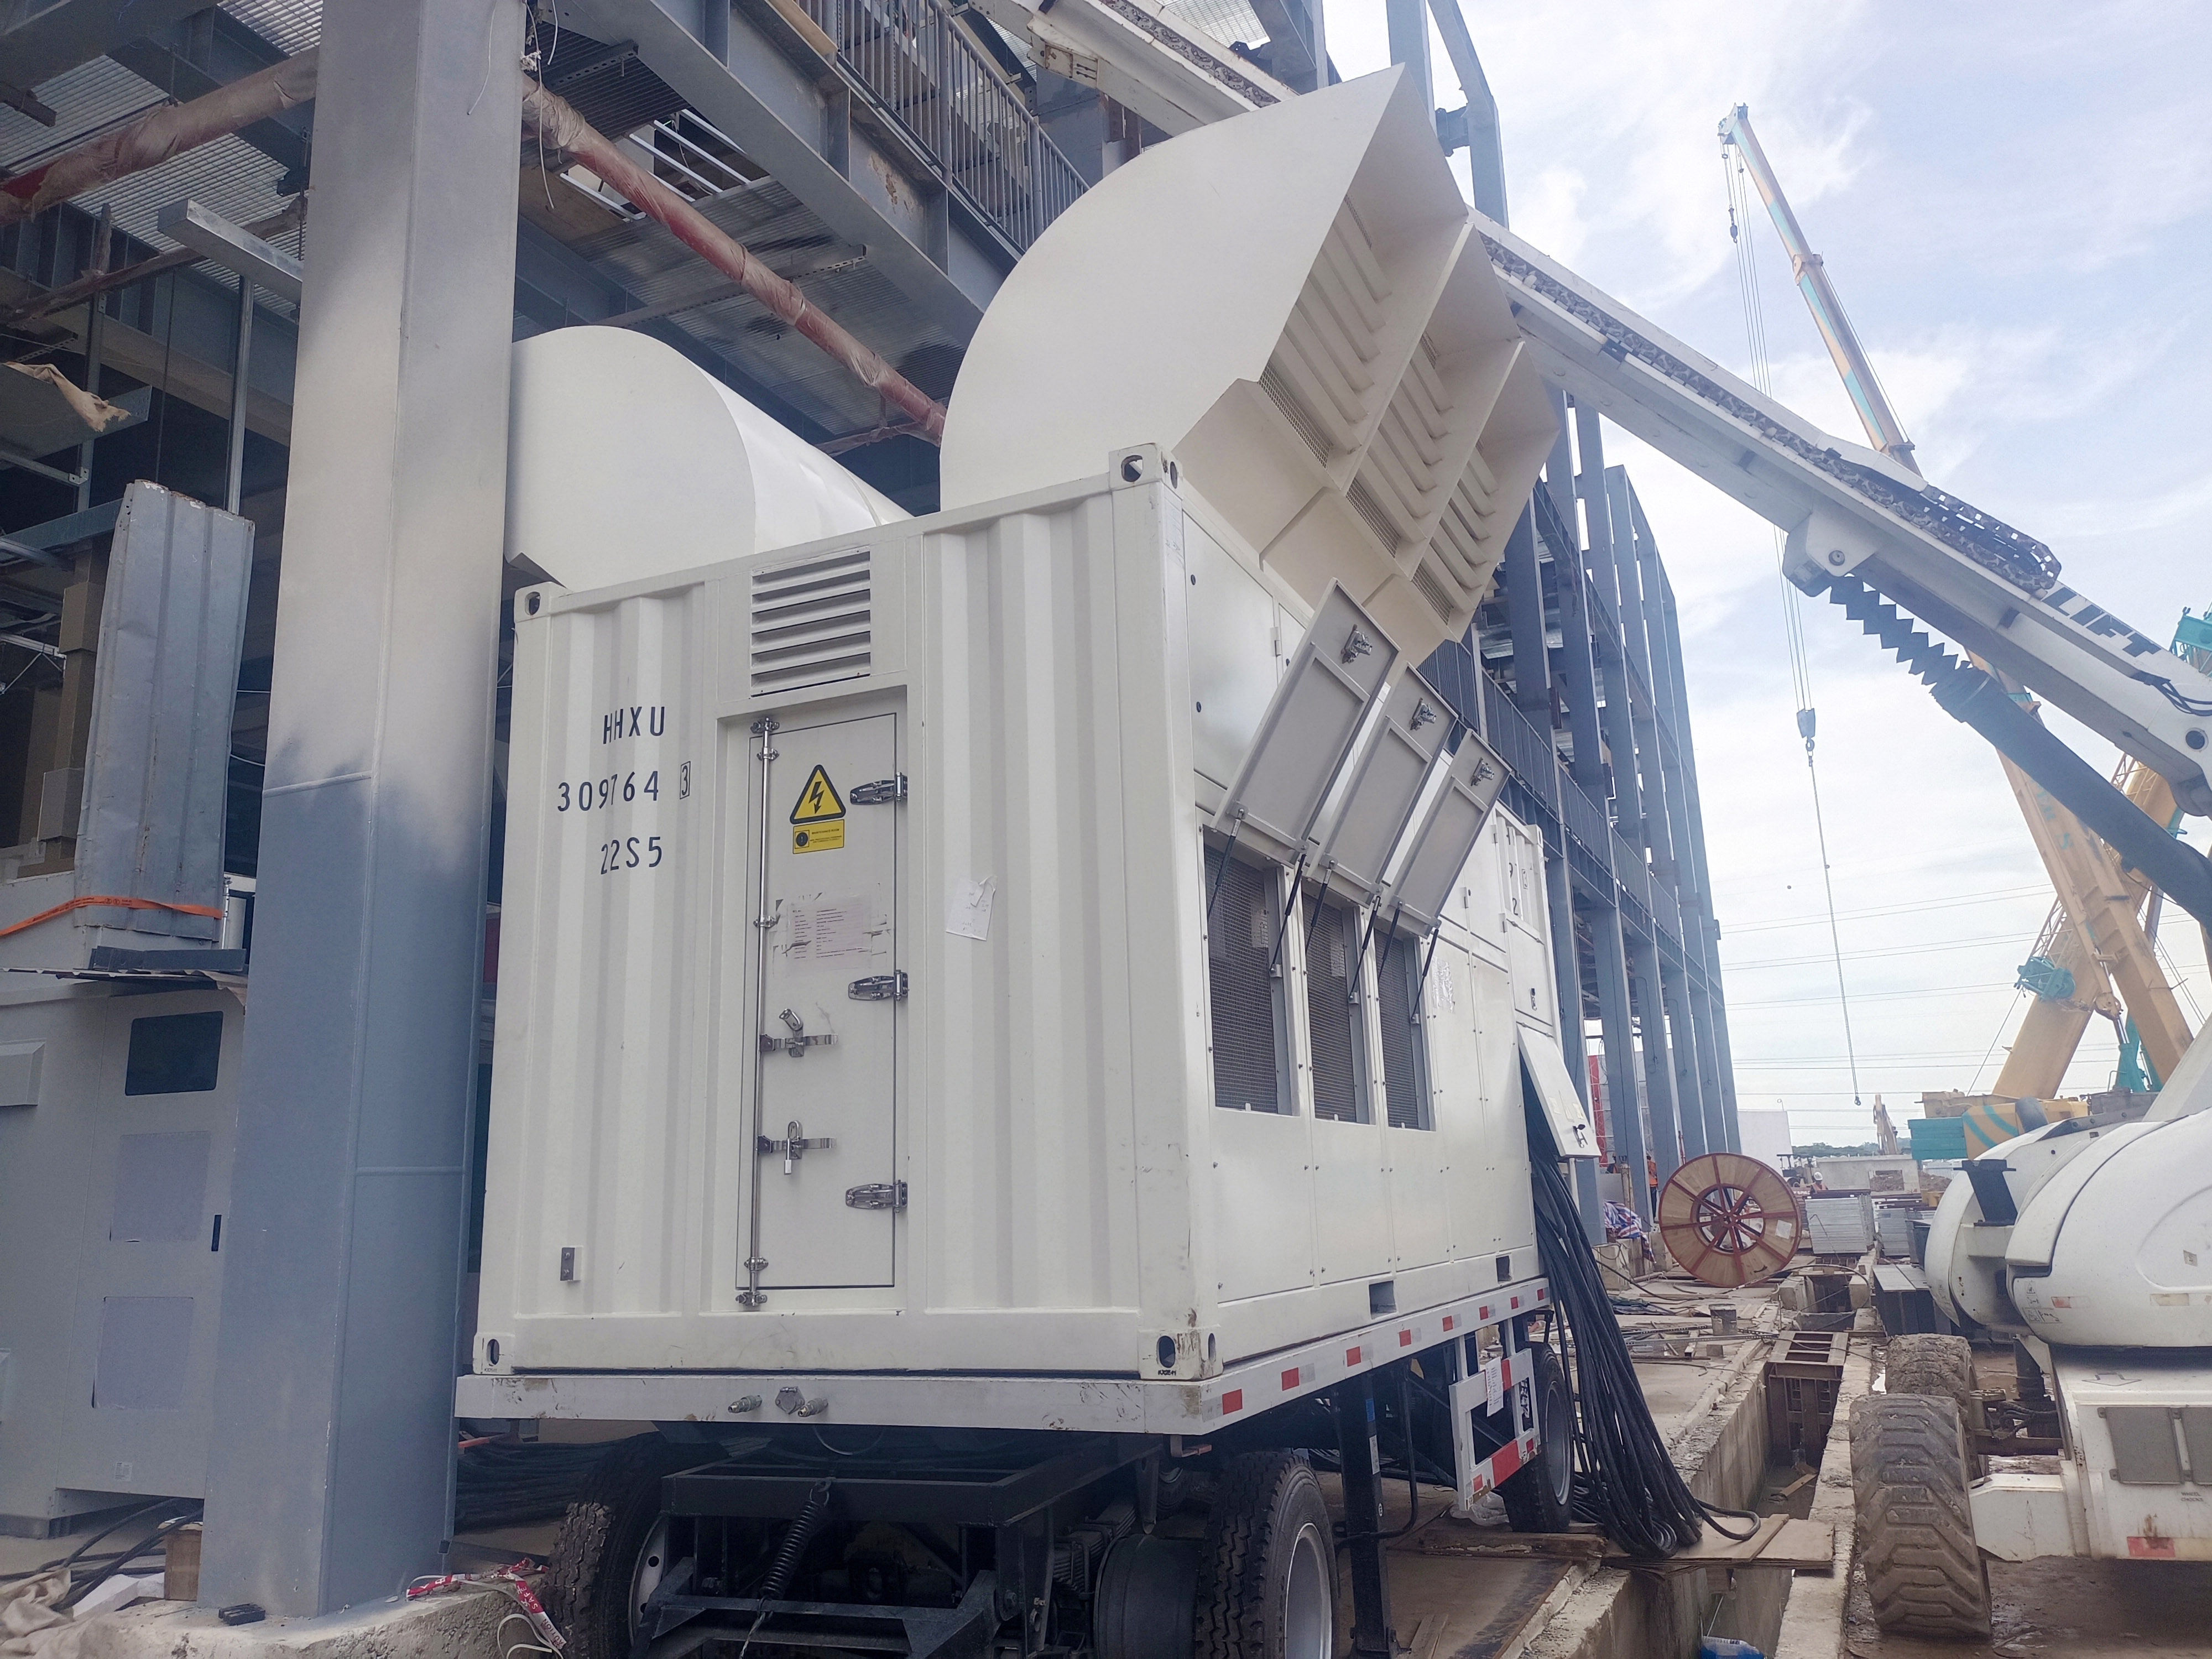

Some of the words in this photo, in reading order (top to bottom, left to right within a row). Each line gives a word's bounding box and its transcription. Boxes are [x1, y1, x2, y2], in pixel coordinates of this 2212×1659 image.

[2041, 587, 2162, 658] LIFT
[603, 706, 665, 744] HHXU
[557, 771, 659, 811] 309764
[681, 764, 689, 797] 3
[601, 836, 662, 874] 22S5
[520, 1586, 538, 1609] SAFE
[542, 1619, 564, 1645] AUTION
